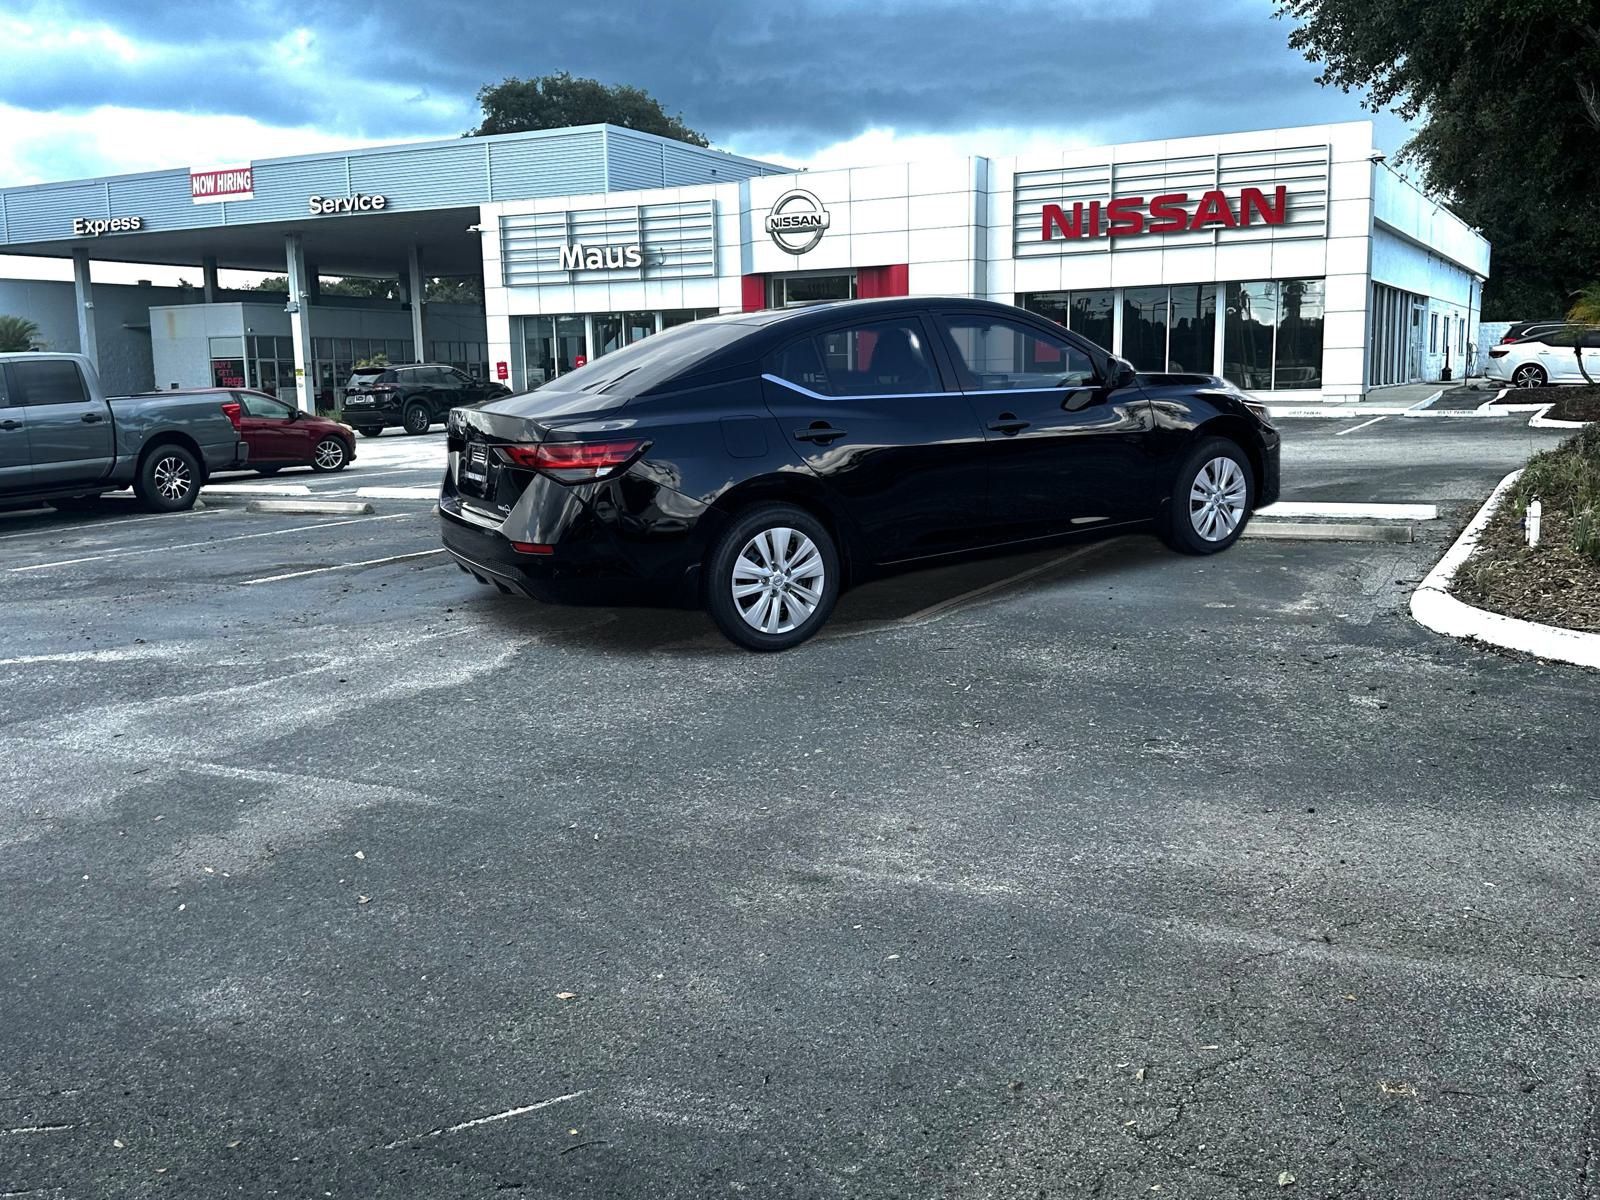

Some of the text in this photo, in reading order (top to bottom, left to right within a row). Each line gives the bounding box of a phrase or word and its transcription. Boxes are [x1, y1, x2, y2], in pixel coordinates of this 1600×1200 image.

[192, 170, 252, 196] NOW HIRING
[309, 193, 386, 215] Service
[1041, 185, 1287, 241] NISSAN
[73, 216, 141, 237] Express
[769, 213, 822, 229] NISSAN
[559, 243, 643, 270] Maus
[222, 377, 244, 386] FREE
